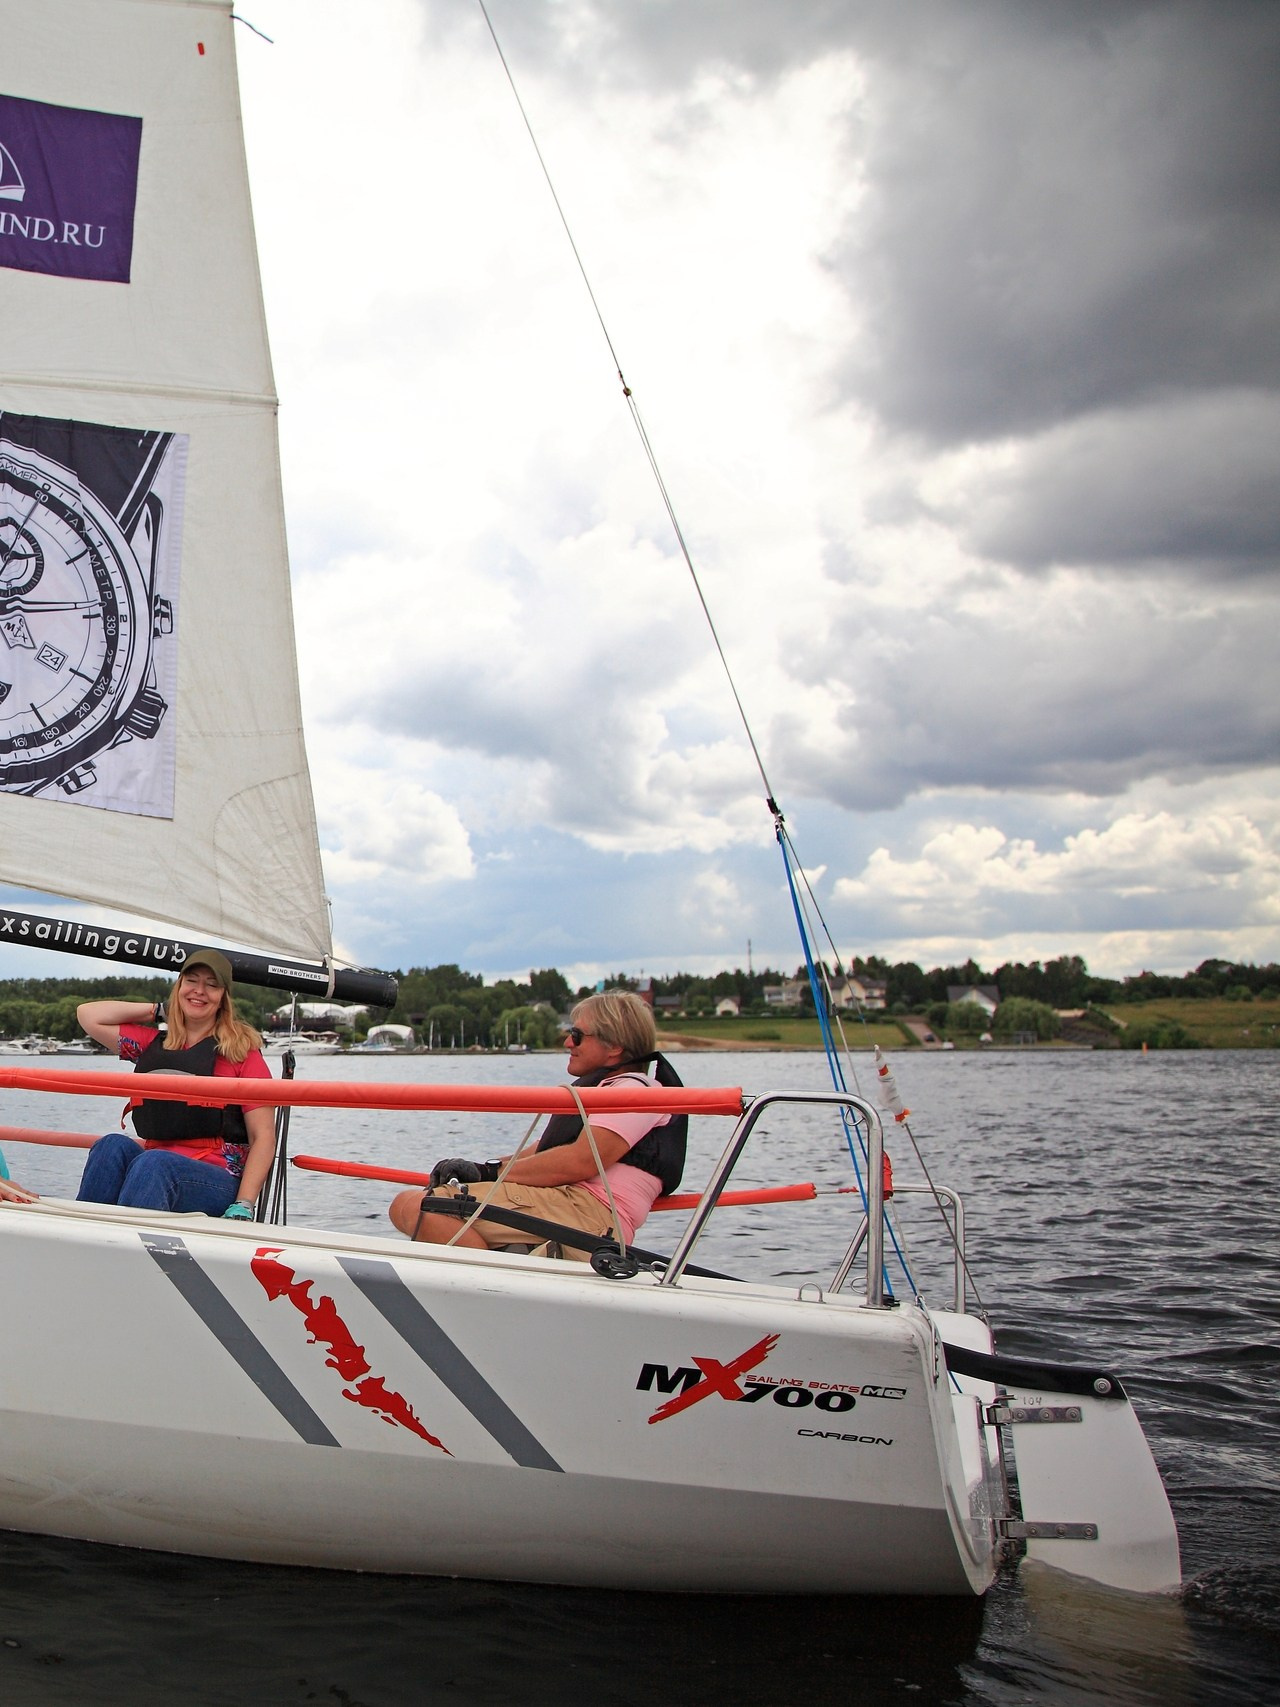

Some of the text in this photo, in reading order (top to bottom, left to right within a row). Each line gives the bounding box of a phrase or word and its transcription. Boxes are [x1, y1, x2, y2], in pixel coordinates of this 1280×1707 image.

[34, 490, 49, 503] 60
[106, 615, 116, 636] 330
[119, 614, 128, 623] 2
[41, 649, 60, 667] 24
[93, 676, 109, 697] 240
[74, 702, 91, 719] 210
[41, 726, 60, 741] 180
[53, 739, 63, 748] 4
[271, 967, 322, 980] WIND BROTHERS
[746, 1374, 804, 1387] SAILING
[808, 1381, 860, 1393] BOATS
[1023, 1396, 1042, 1406] 104
[797, 1429, 894, 1446] CARBON
